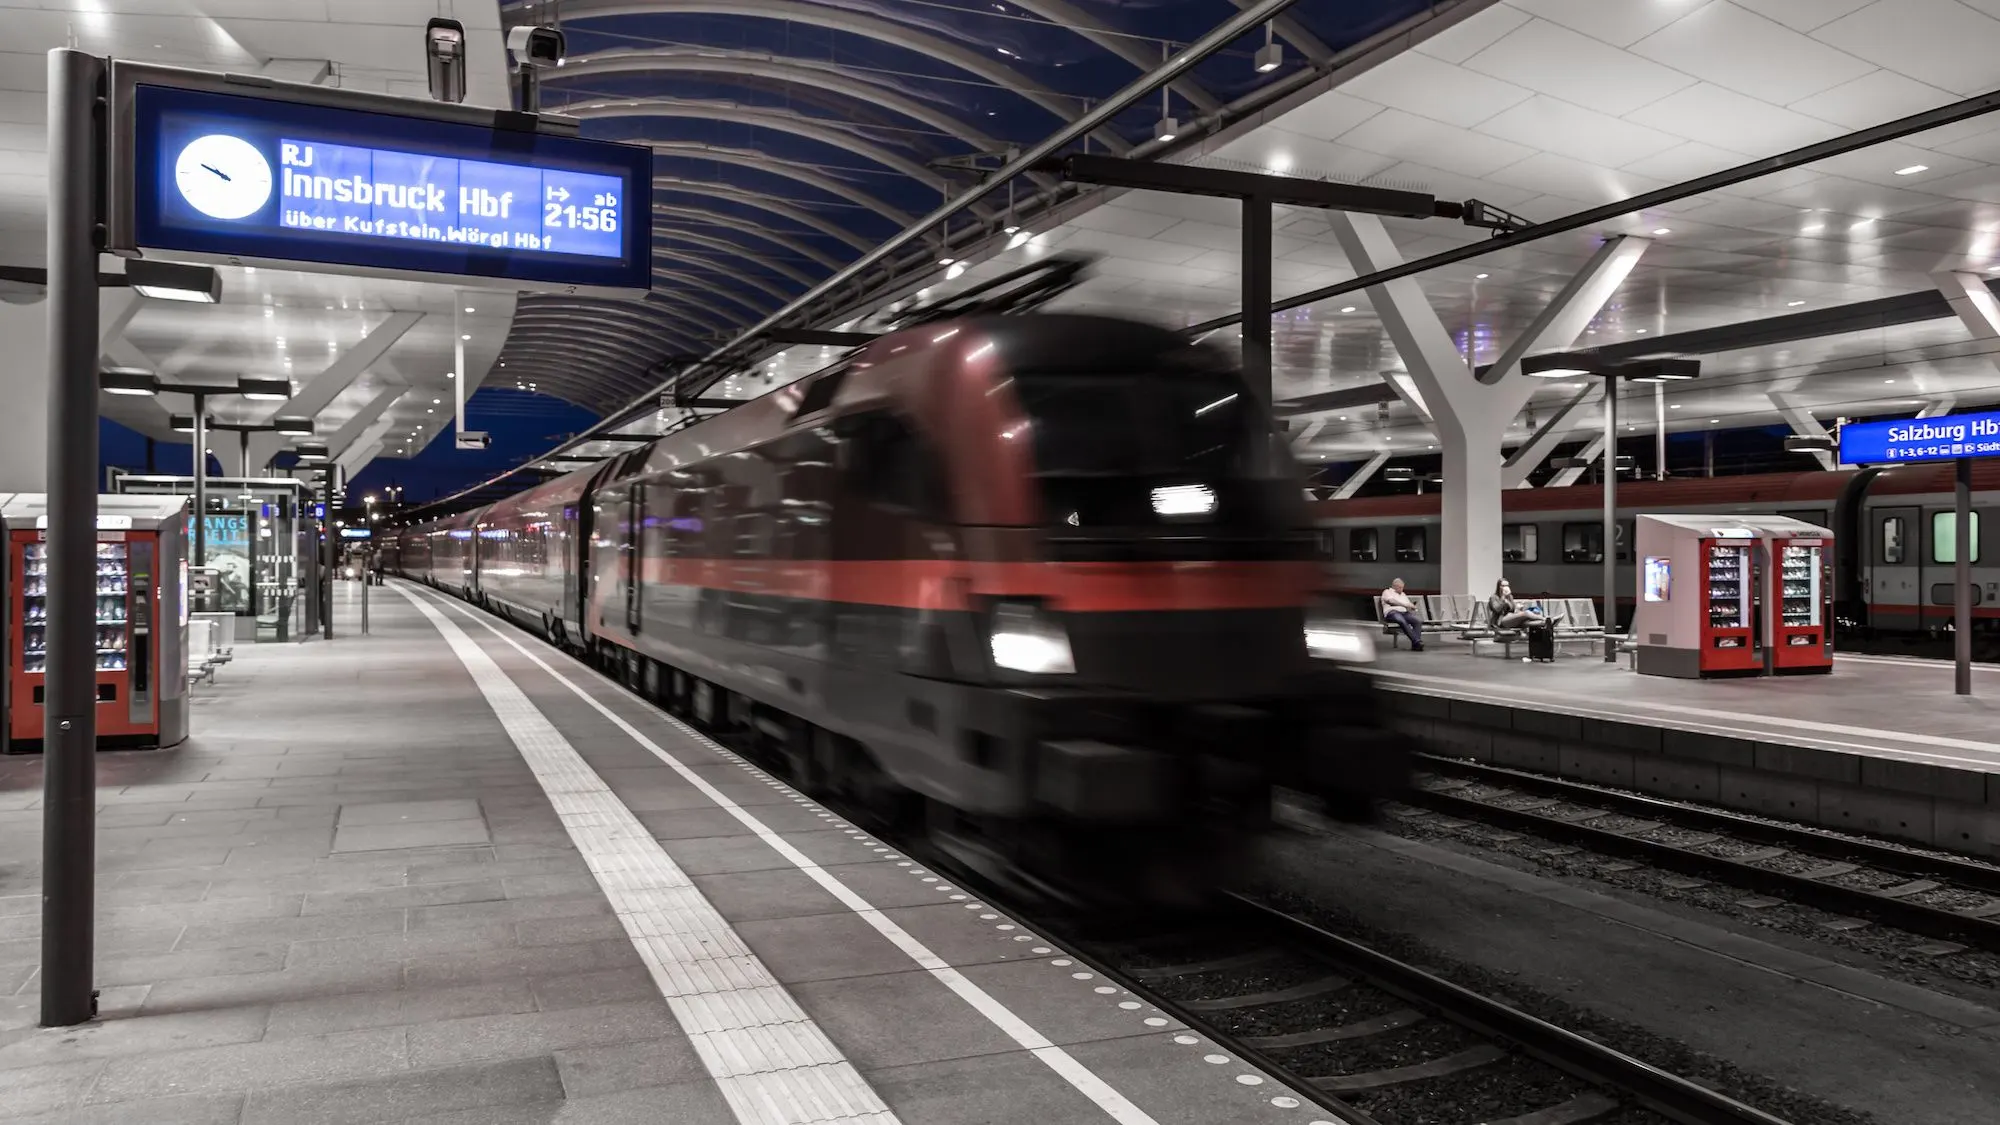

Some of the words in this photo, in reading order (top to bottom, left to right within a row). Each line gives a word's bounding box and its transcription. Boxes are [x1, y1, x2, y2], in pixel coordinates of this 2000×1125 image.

[281, 143, 313, 167] RJ
[283, 167, 446, 213] Innsbruck
[459, 186, 513, 219] Hbf
[594, 192, 617, 207] ab
[285, 209, 337, 229] über
[515, 232, 552, 250] Hbf
[544, 203, 617, 232] 21:56
[1888, 423, 1965, 442] Salzburg
[1971, 418, 2000, 436] Hb
